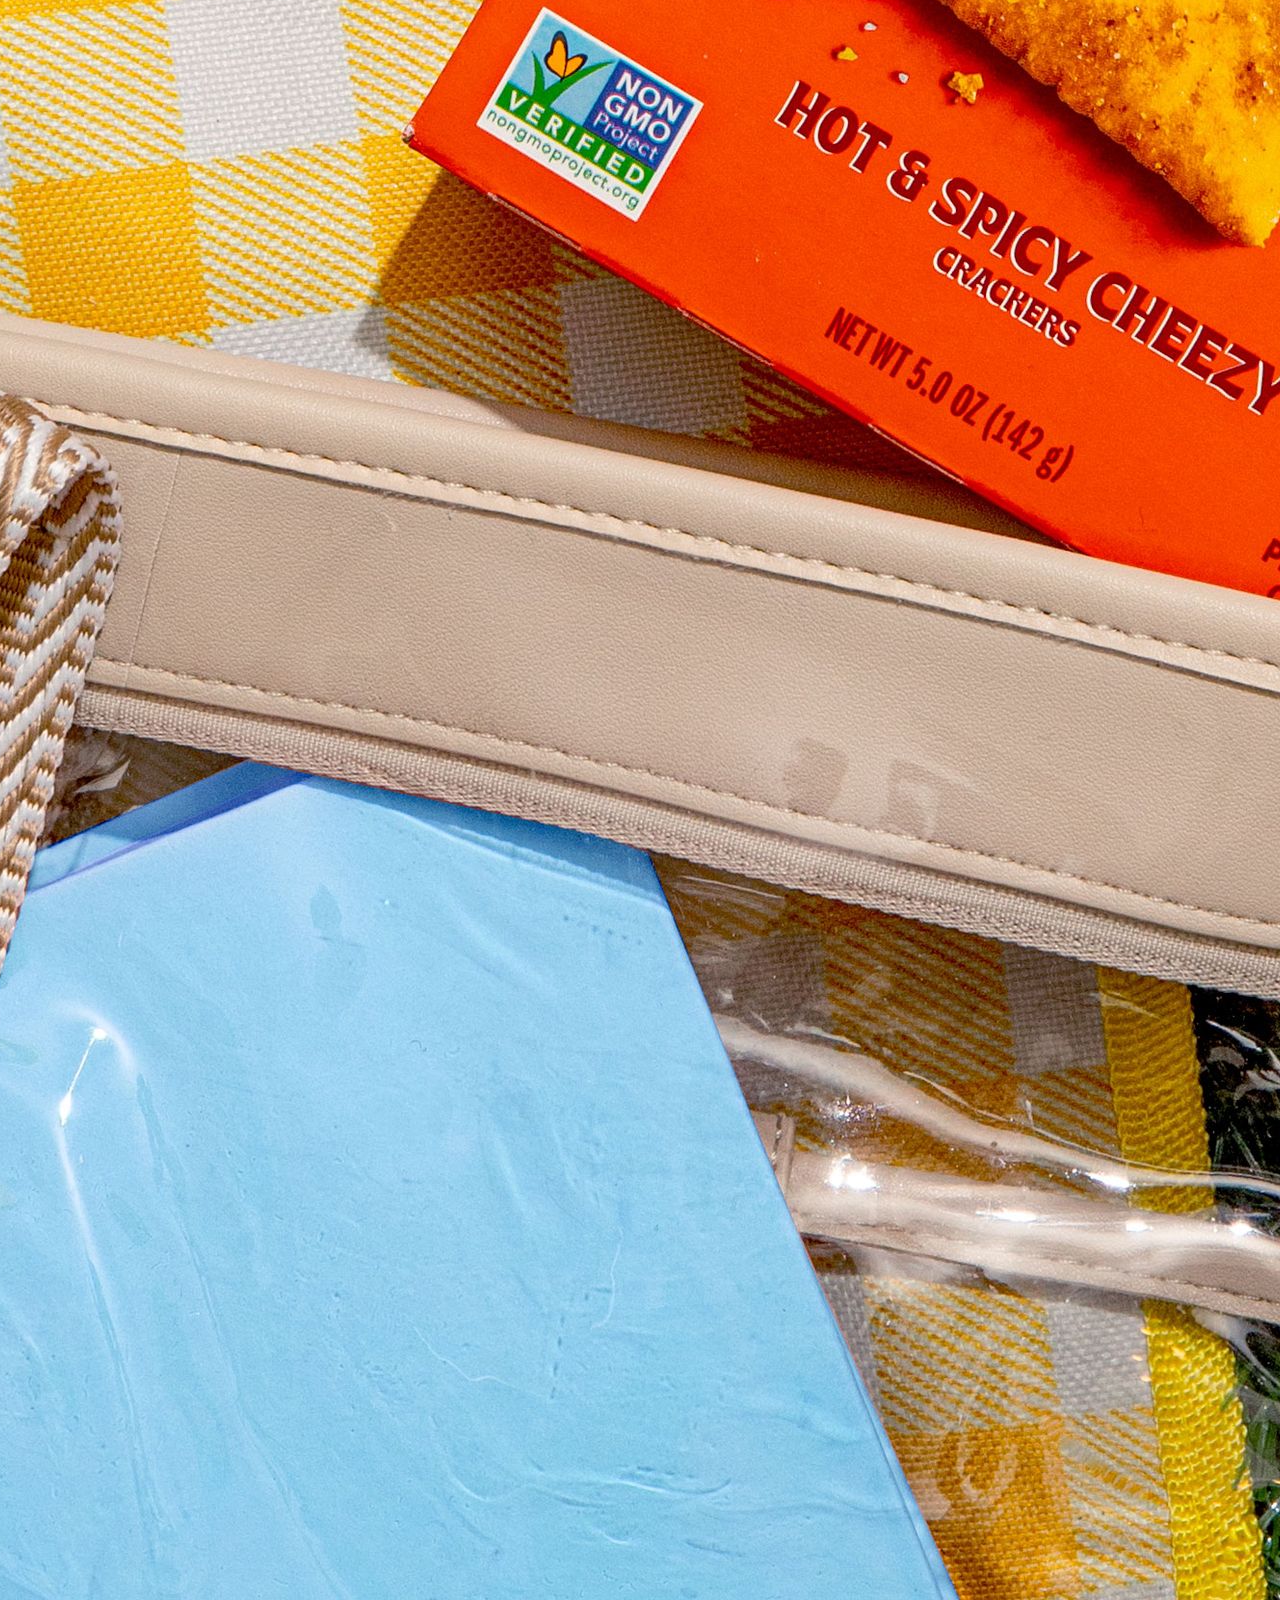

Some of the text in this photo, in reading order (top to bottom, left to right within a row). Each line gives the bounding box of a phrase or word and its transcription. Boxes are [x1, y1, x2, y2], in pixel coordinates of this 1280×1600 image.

[509, 90, 645, 186] VERIFIED
[593, 110, 660, 164] Project
[604, 93, 671, 144] GMO
[615, 71, 684, 124] NON
[485, 108, 640, 211] nongmoproject.org
[773, 79, 894, 175] HOT
[886, 149, 932, 203] &
[928, 175, 1093, 293] SPICY
[932, 245, 1082, 349] CRACKERS
[824, 306, 1077, 484] NET WT 5.0 OZ (142 g)
